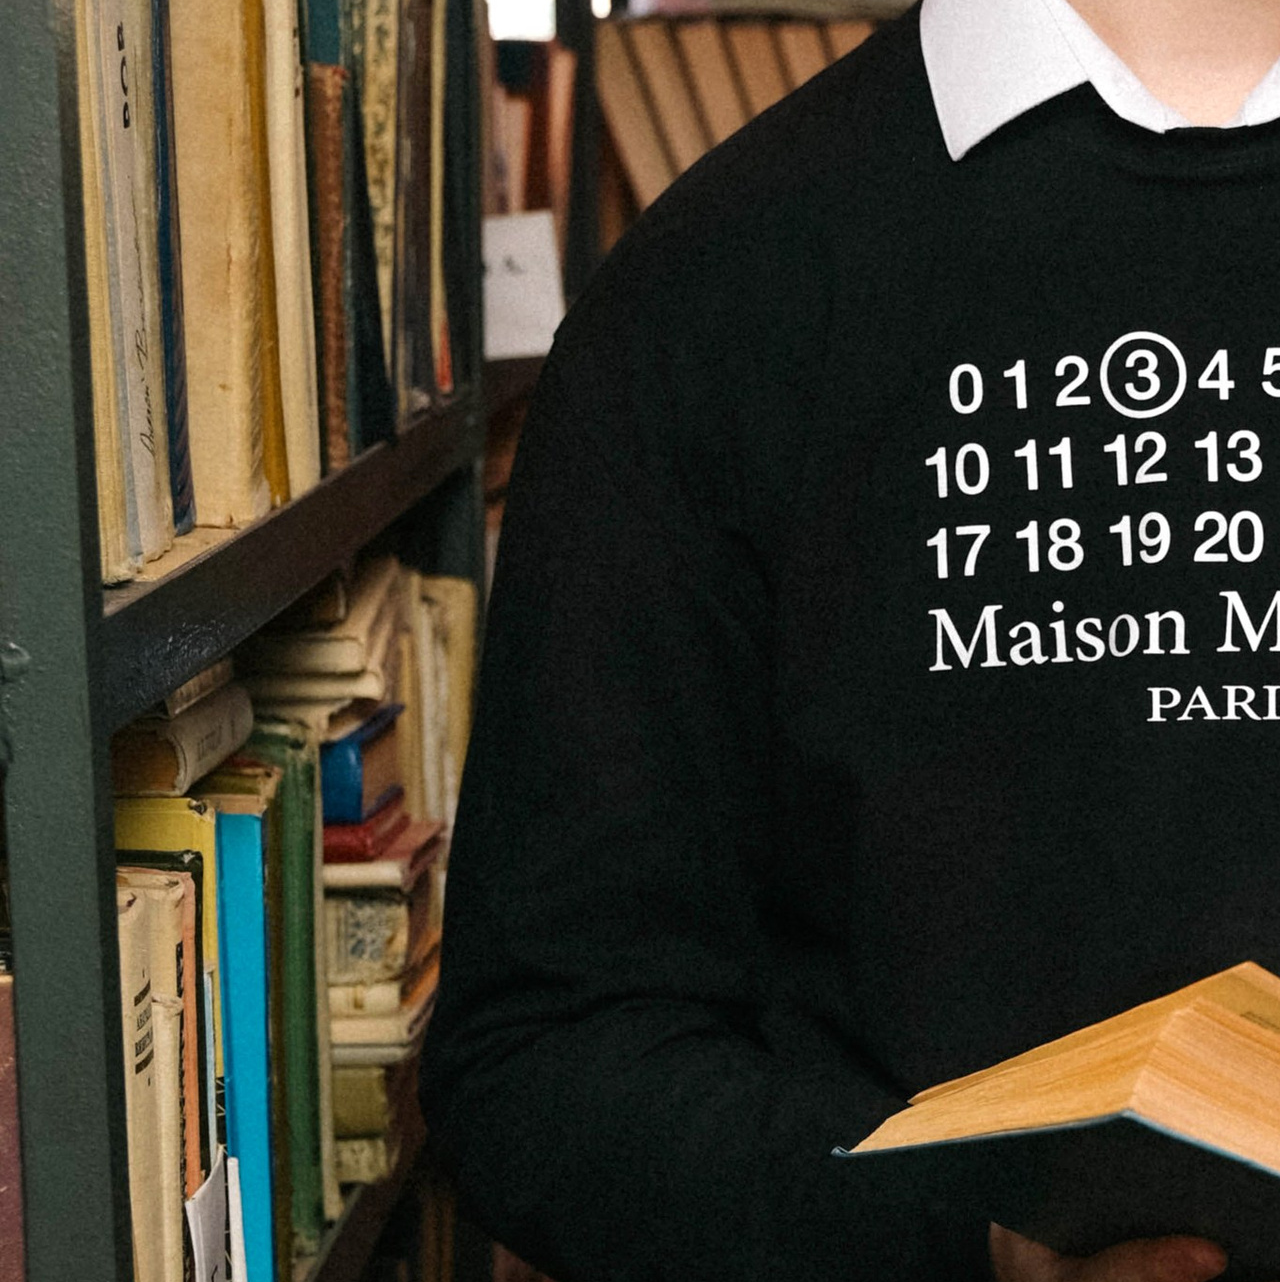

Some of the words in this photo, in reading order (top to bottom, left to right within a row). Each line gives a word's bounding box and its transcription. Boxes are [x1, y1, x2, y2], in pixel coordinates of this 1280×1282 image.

[949, 364, 983, 414] 0
[1004, 360, 1027, 409] 1
[1055, 355, 1091, 406] 2
[1125, 349, 1160, 400] 3
[1198, 349, 1235, 400] 4
[925, 443, 989, 498] 10
[1015, 437, 1073, 490] 11
[1104, 431, 1167, 485] 12
[1195, 430, 1262, 482] 13
[927, 525, 990, 578] 17
[1016, 518, 1084, 572] 18
[1109, 512, 1171, 566] 19
[1194, 511, 1264, 562] 20
[928, 601, 1190, 671] Maison
